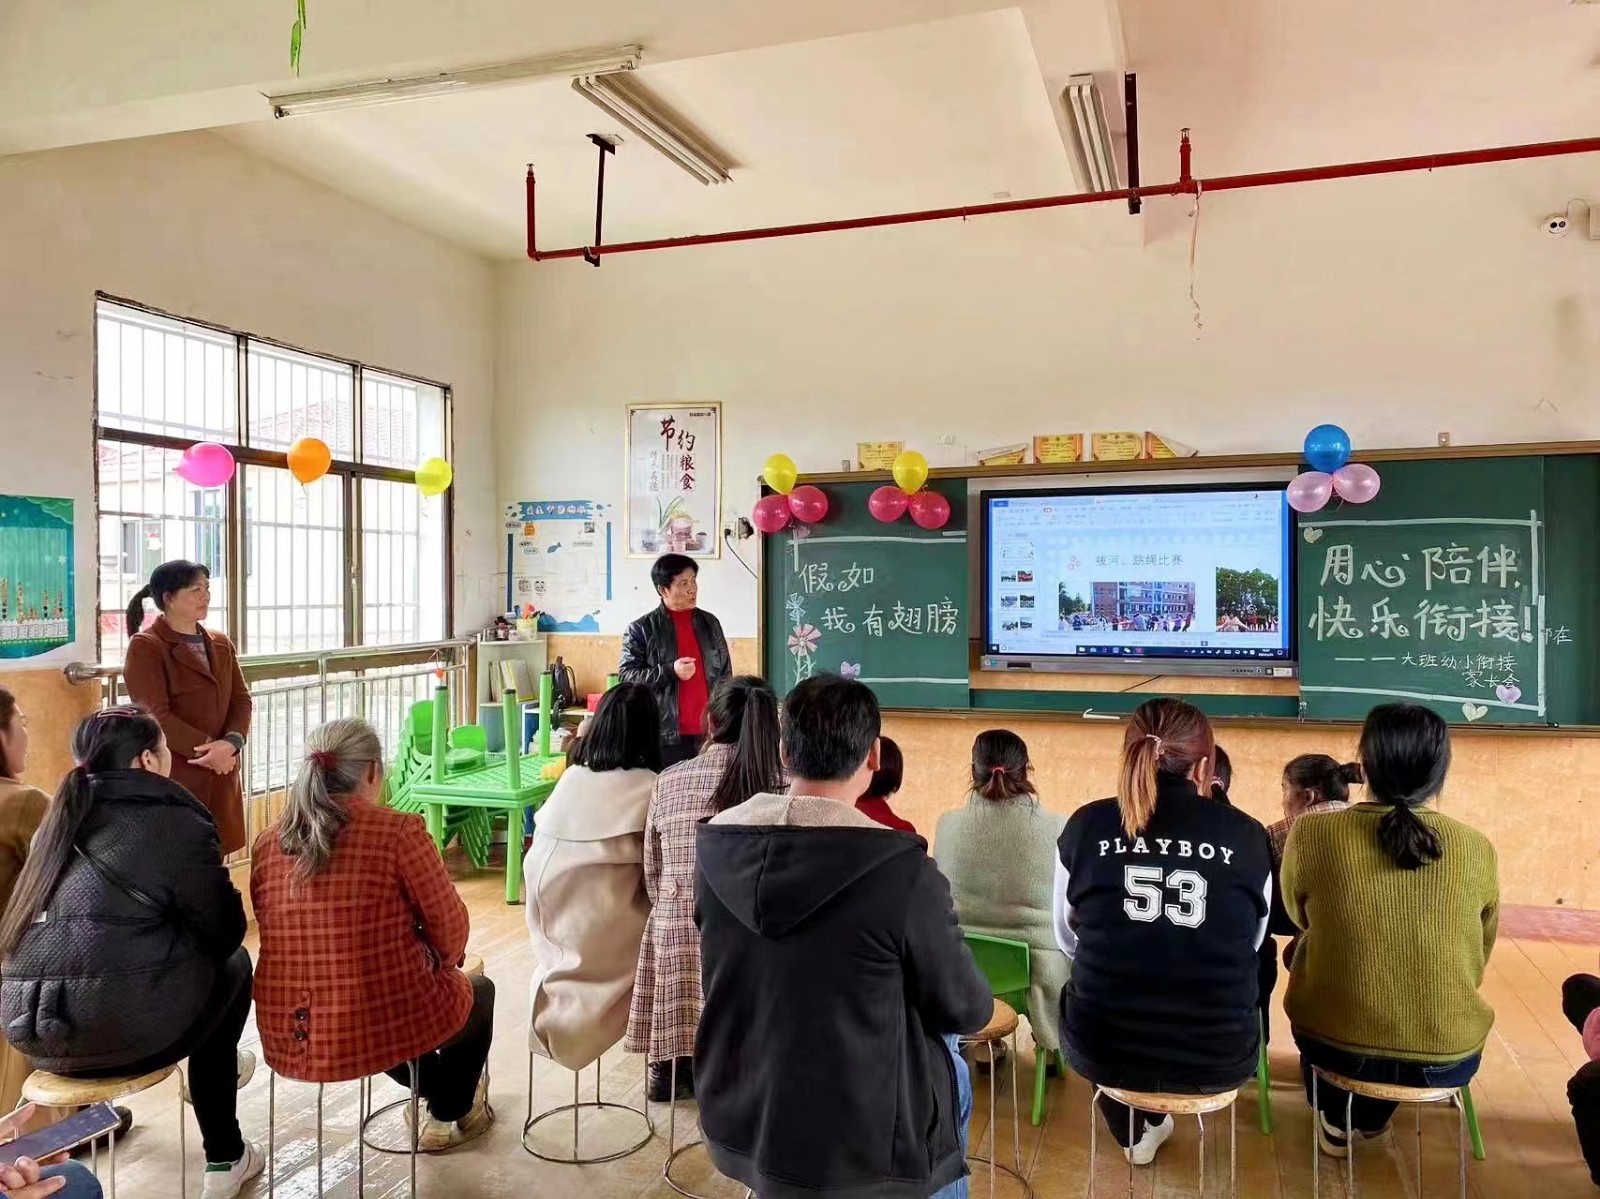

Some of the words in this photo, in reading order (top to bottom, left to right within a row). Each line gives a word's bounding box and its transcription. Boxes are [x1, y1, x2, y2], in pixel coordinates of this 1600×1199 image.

[798, 561, 875, 594] 假如
[820, 596, 959, 637] 我有翅膀
[1098, 836, 1235, 865] PLAYBOY
[1123, 864, 1208, 929] 53
